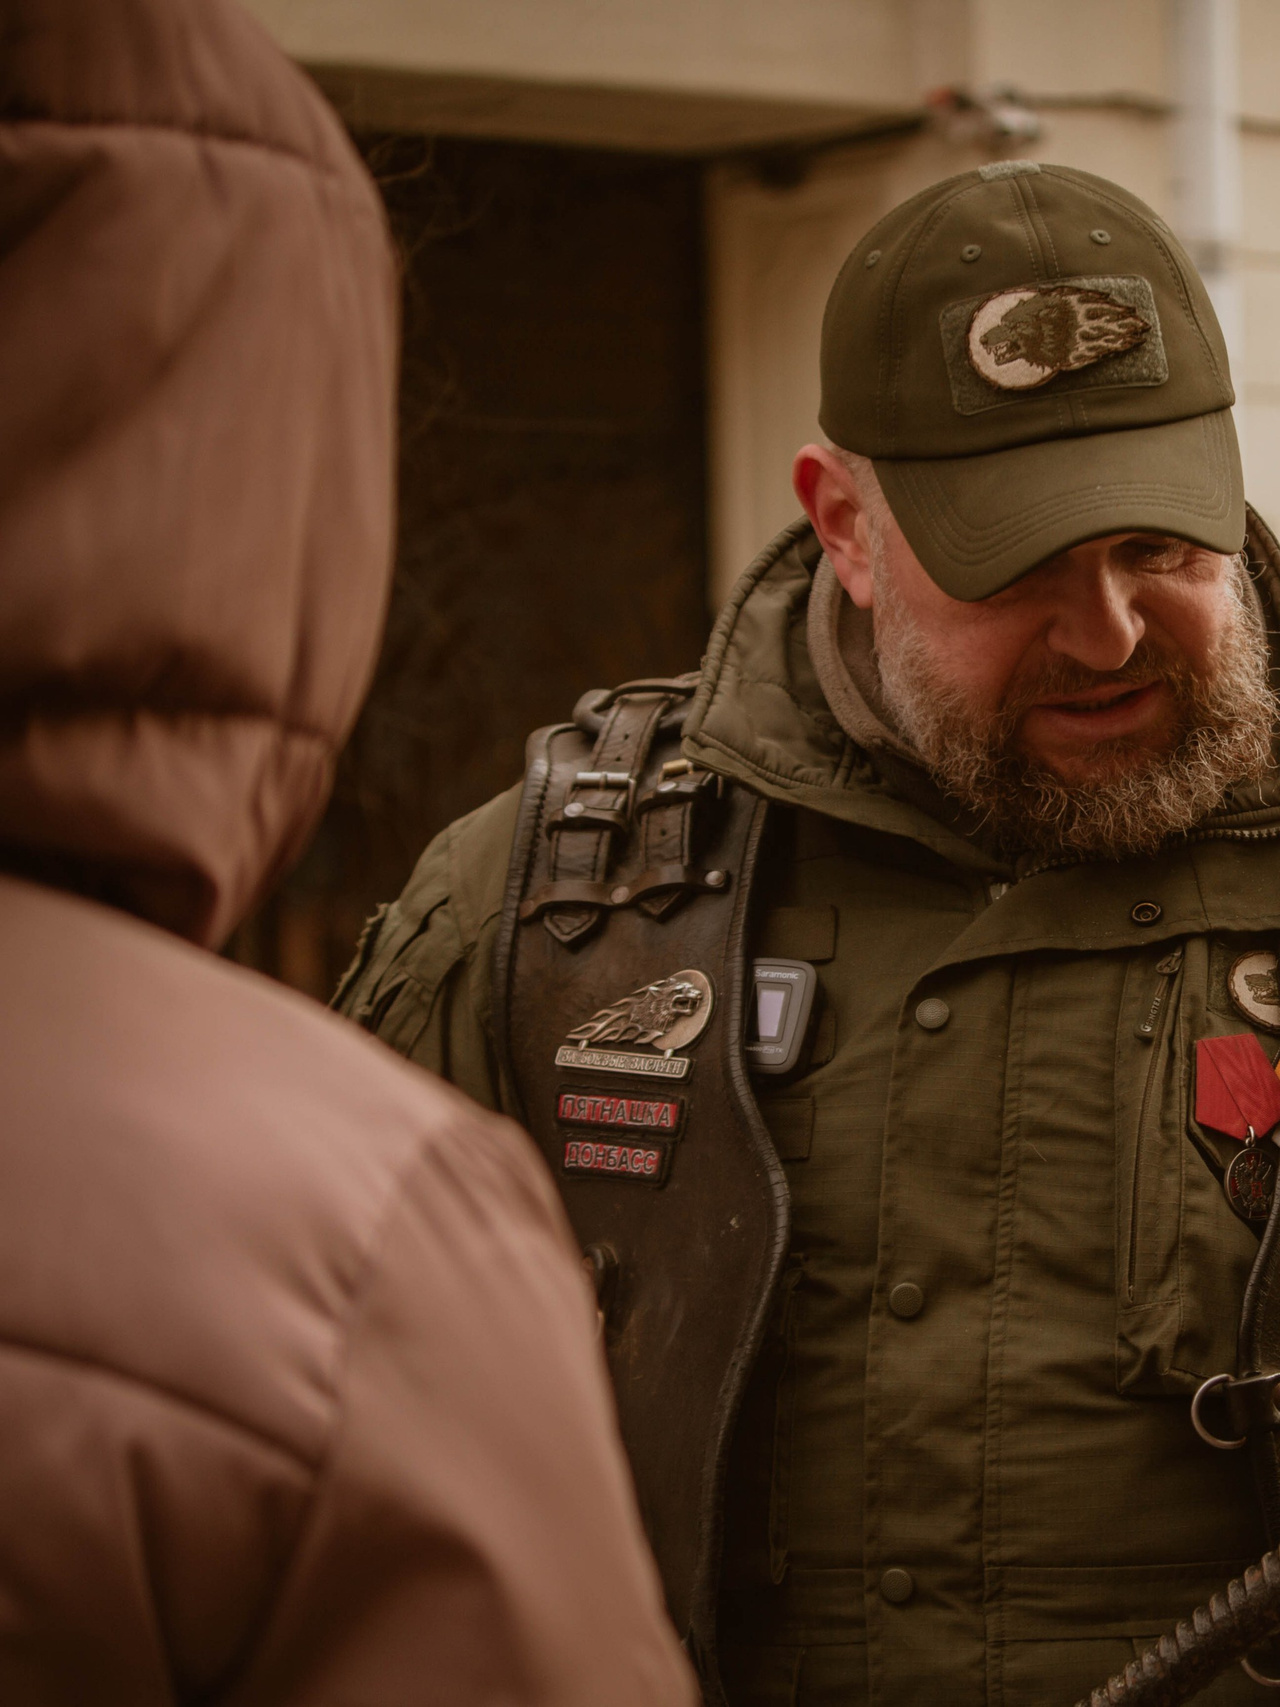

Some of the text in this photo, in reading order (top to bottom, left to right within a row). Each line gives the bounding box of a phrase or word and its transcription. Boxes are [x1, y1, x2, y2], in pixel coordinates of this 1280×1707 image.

[755, 968, 799, 980] Saramonic
[561, 1049, 576, 1063] ЗА
[630, 1057, 682, 1074] ЗАСЛУГИ
[561, 1094, 671, 1127] ПЯТНАШКА
[565, 1142, 657, 1173] ДОНБАСС
